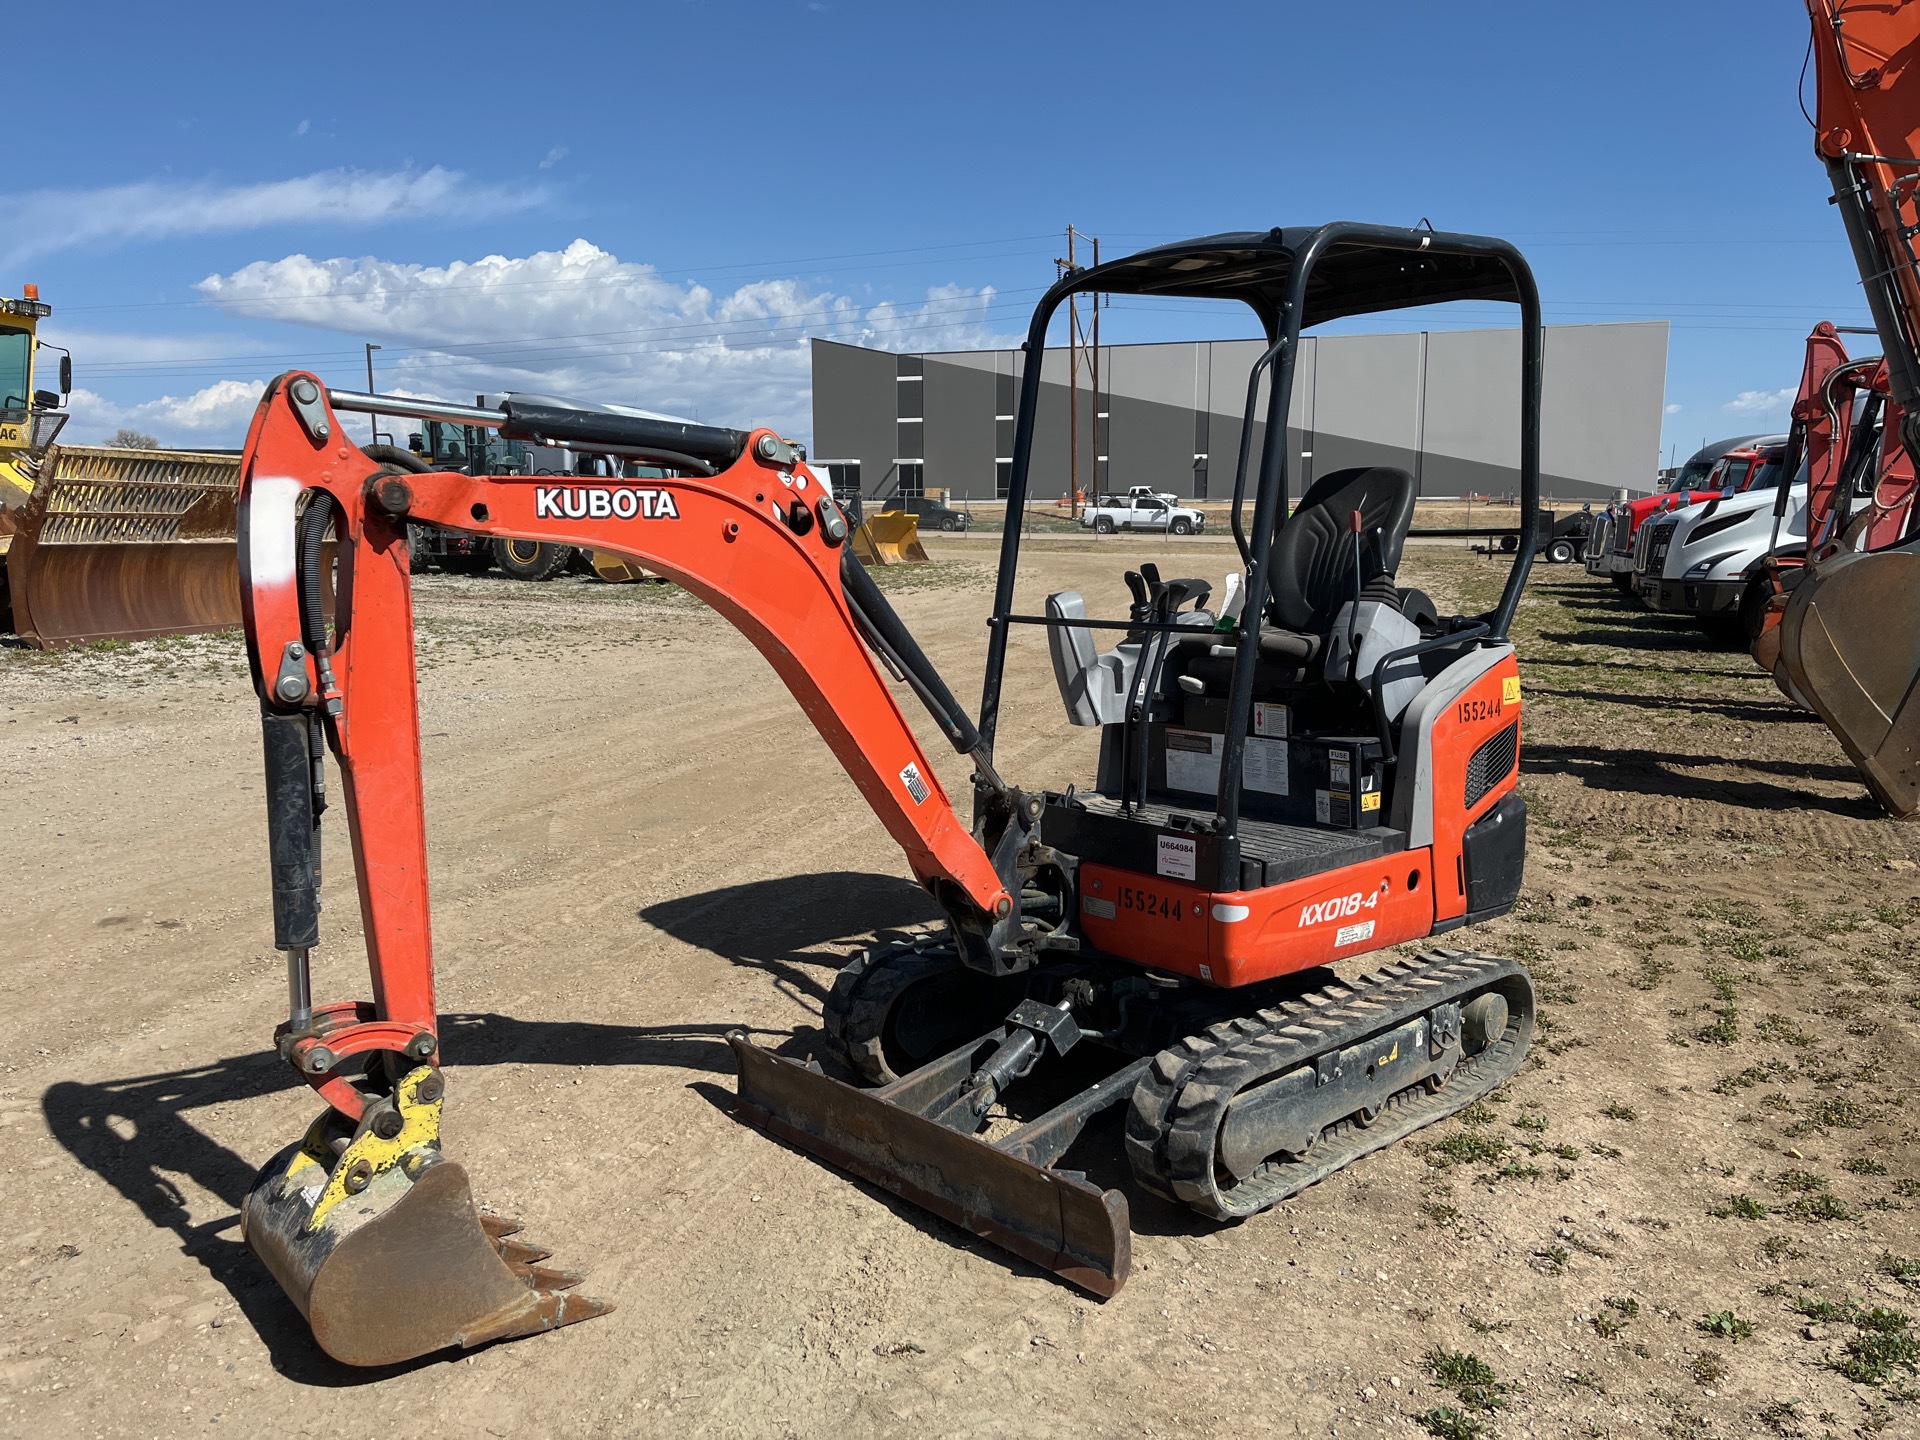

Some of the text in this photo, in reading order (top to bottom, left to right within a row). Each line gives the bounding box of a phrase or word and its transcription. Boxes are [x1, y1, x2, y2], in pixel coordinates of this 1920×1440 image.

[535, 487, 679, 519] KUBOTA
[1458, 698, 1501, 724] 155244
[1330, 751, 1348, 760] FUSE
[1160, 840, 1194, 854] U664984
[1117, 885, 1182, 922] 155244
[1297, 890, 1379, 928] KX018-4
